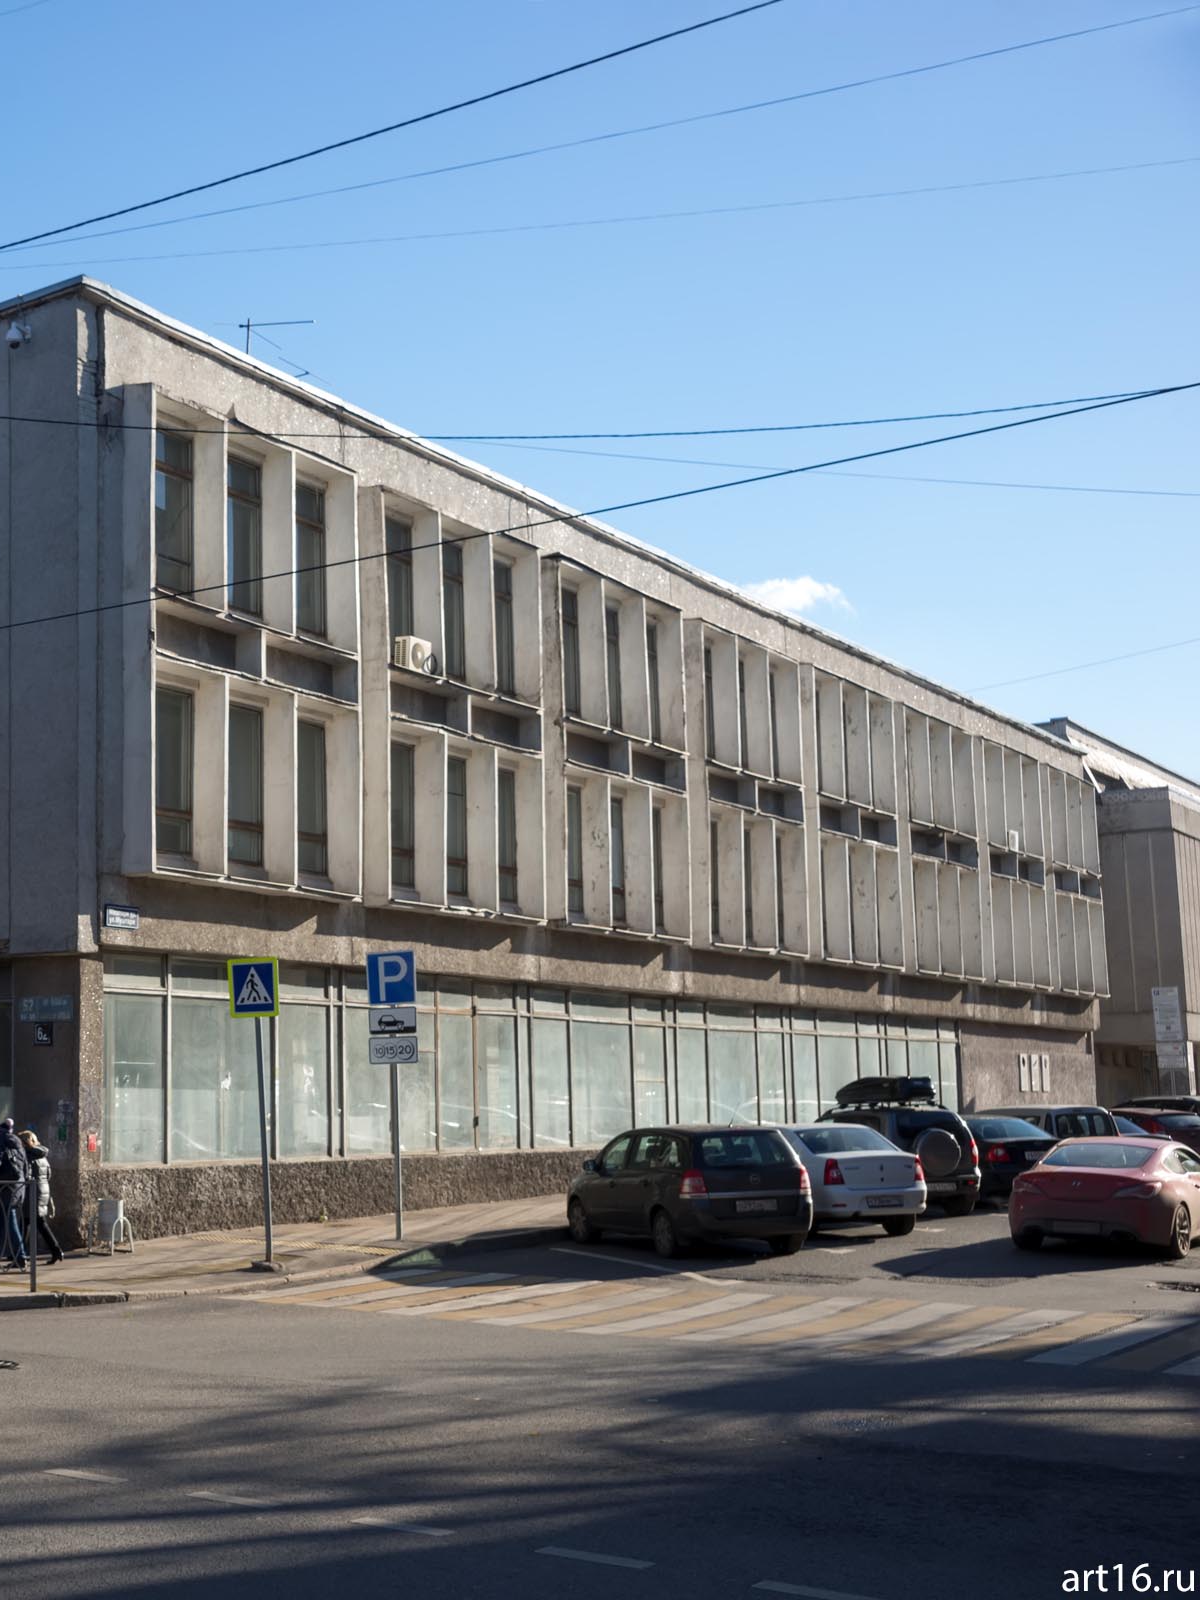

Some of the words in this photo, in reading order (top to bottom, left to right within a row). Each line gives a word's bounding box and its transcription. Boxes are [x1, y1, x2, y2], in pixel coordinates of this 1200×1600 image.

[377, 955, 408, 1002] P
[375, 1047, 384, 1055] 10
[385, 1046, 395, 1055] 15
[398, 1044, 412, 1055] 20
